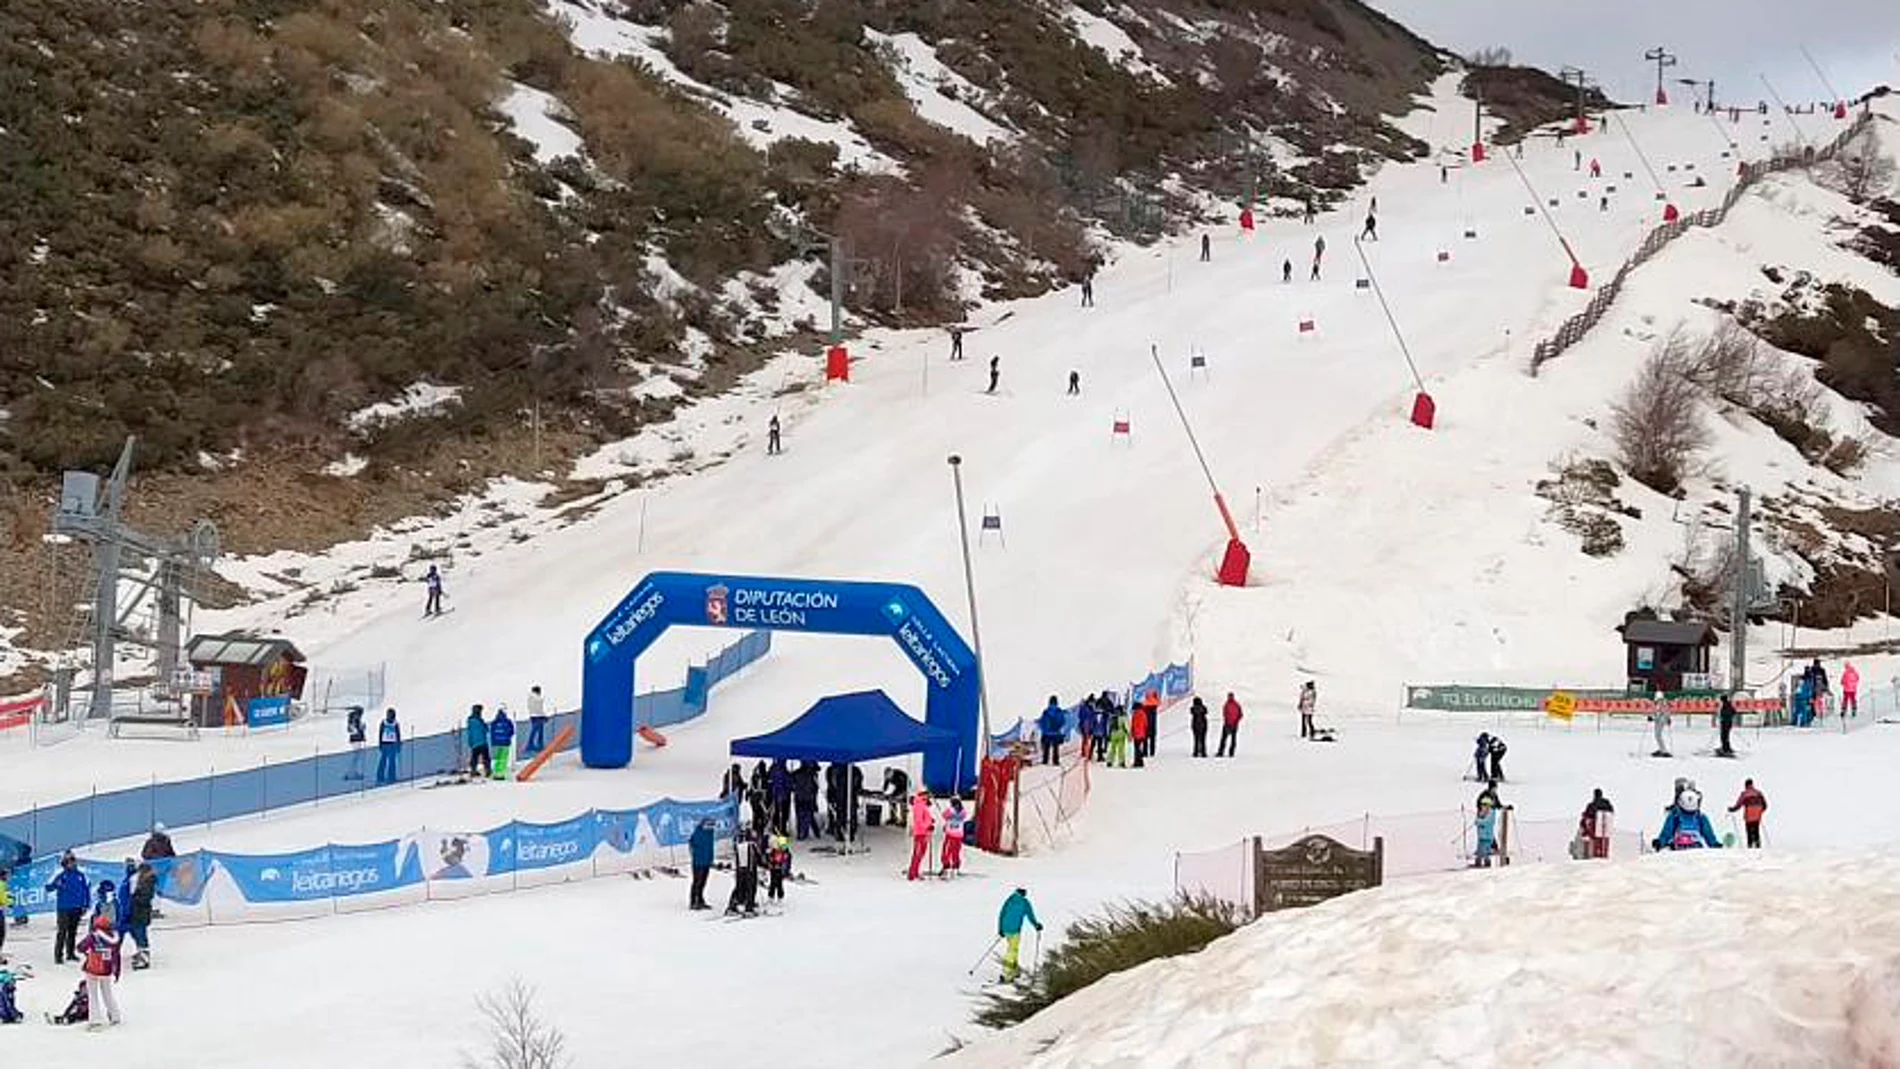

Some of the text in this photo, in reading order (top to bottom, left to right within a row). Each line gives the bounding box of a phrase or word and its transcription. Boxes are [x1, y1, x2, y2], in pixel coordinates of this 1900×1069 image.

[735, 588, 838, 609] DIPUTACIÓN
[735, 607, 806, 626] DE LEÓN
